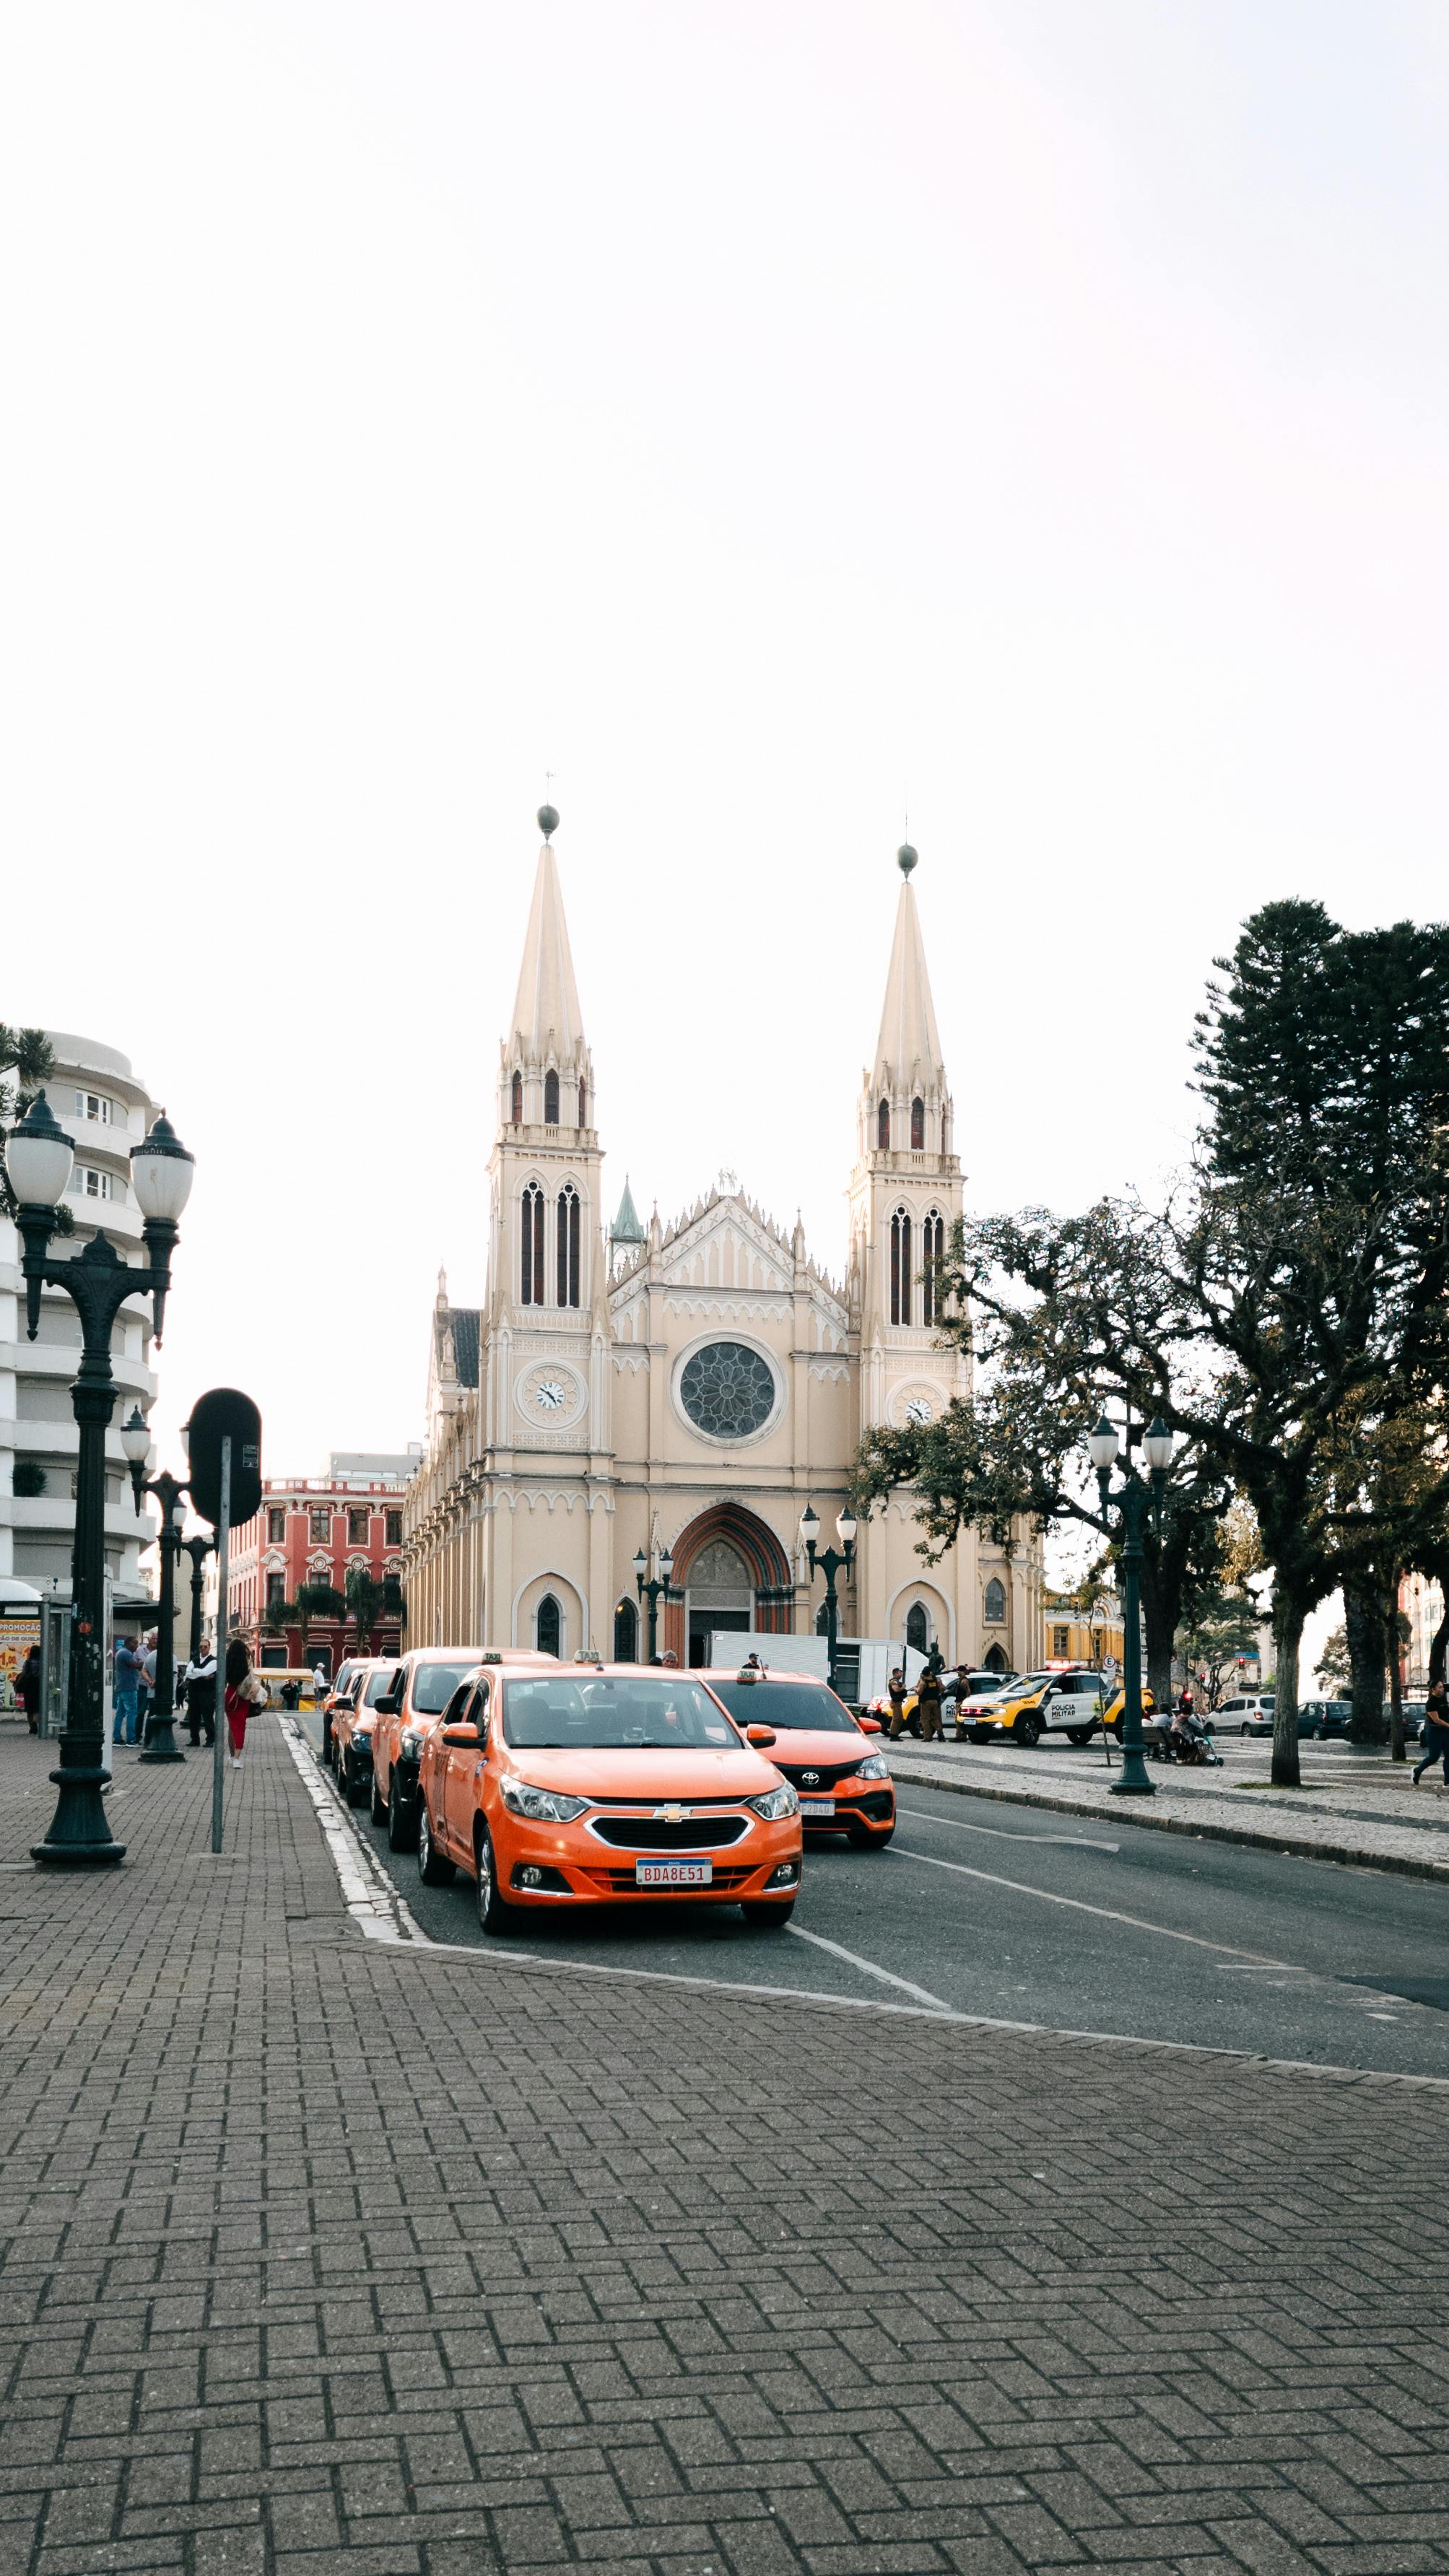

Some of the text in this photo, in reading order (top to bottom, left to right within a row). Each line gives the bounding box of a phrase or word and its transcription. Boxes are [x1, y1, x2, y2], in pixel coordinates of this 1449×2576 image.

[0, 1623, 40, 1632] PROMOÇÃO
[579, 1651, 599, 1660] TAXI
[645, 1867, 704, 1881] BDA8E51
